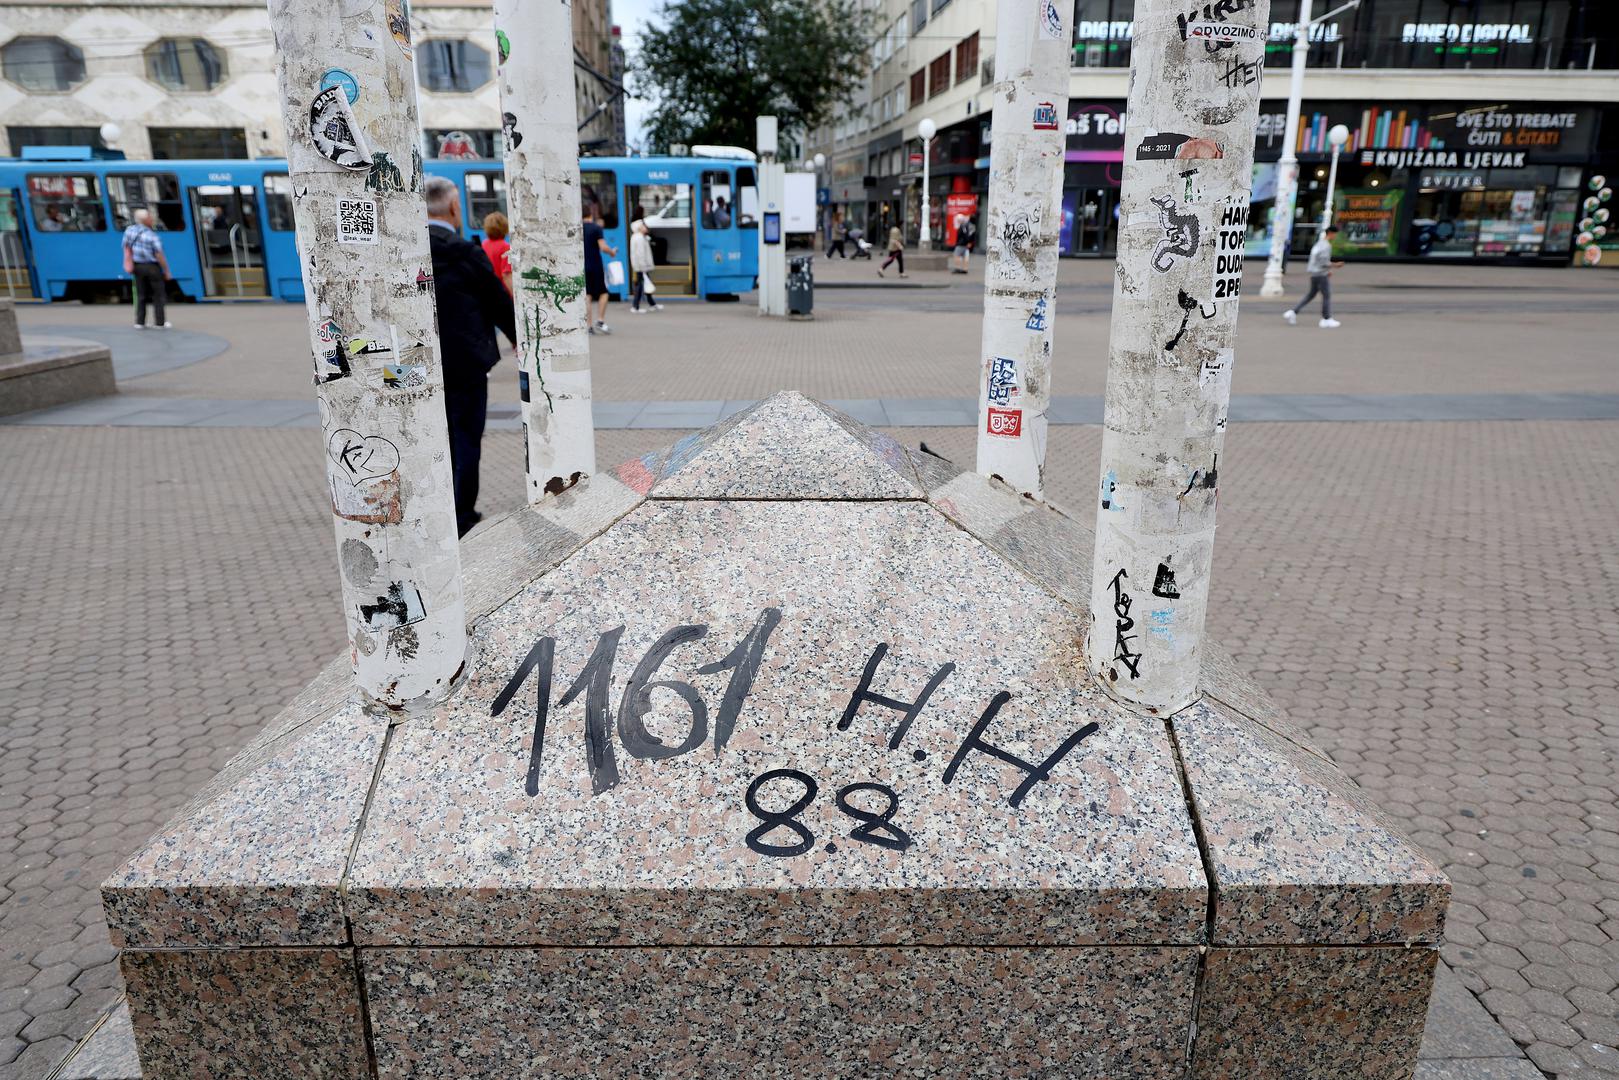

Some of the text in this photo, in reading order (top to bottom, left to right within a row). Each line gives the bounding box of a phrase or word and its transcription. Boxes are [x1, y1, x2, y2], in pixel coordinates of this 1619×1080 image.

[1456, 110, 1577, 129] SVE ŠTO TREBATE
[1467, 129, 1501, 146] ČUTI
[1156, 144, 1171, 152] 2021
[1375, 148, 1526, 169] KNJIŽARA LJEVAK
[491, 607, 782, 797] 1161
